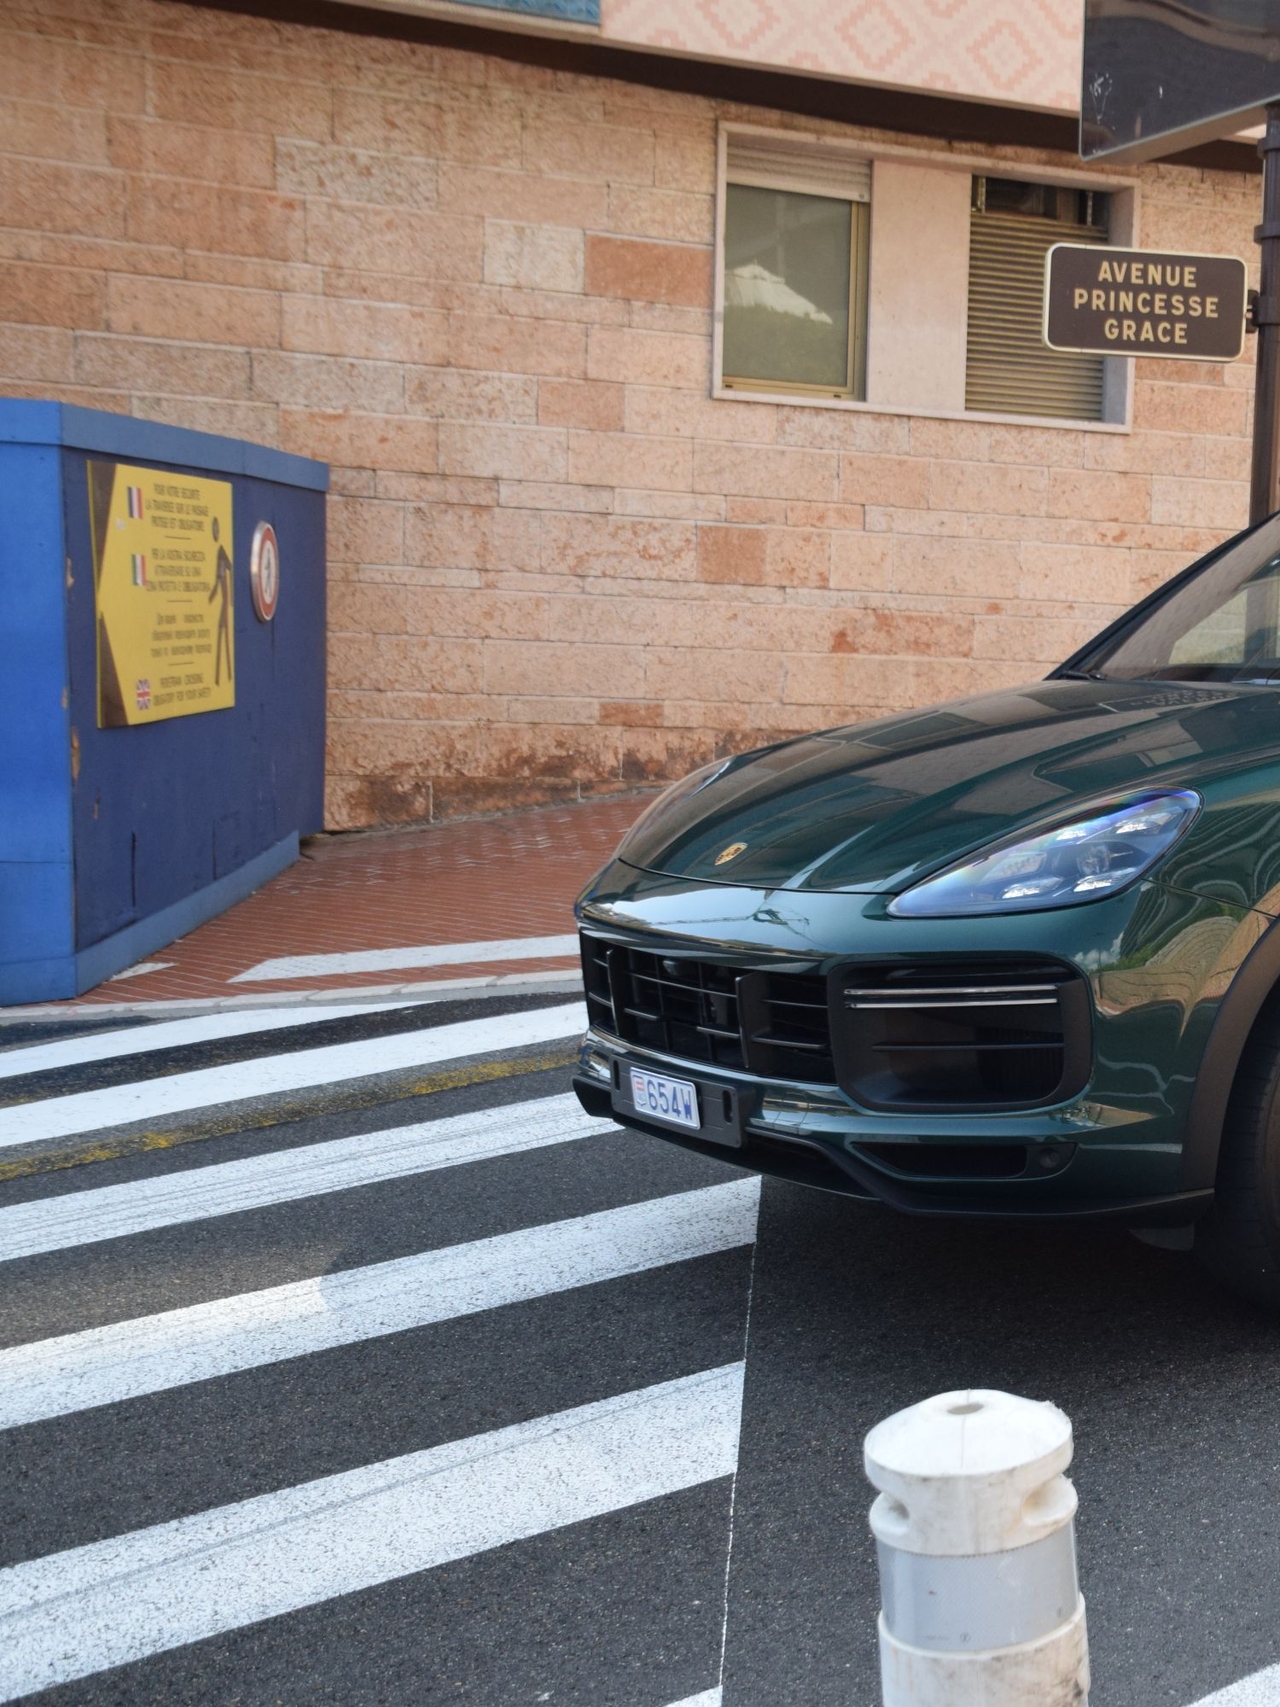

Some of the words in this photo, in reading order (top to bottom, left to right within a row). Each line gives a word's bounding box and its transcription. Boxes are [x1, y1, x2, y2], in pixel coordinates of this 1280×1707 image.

[1098, 261, 1197, 288] AVENUE
[1074, 288, 1219, 318] PRINCESSE
[1104, 319, 1188, 344] GRACE
[647, 1080, 692, 1120] 654W
